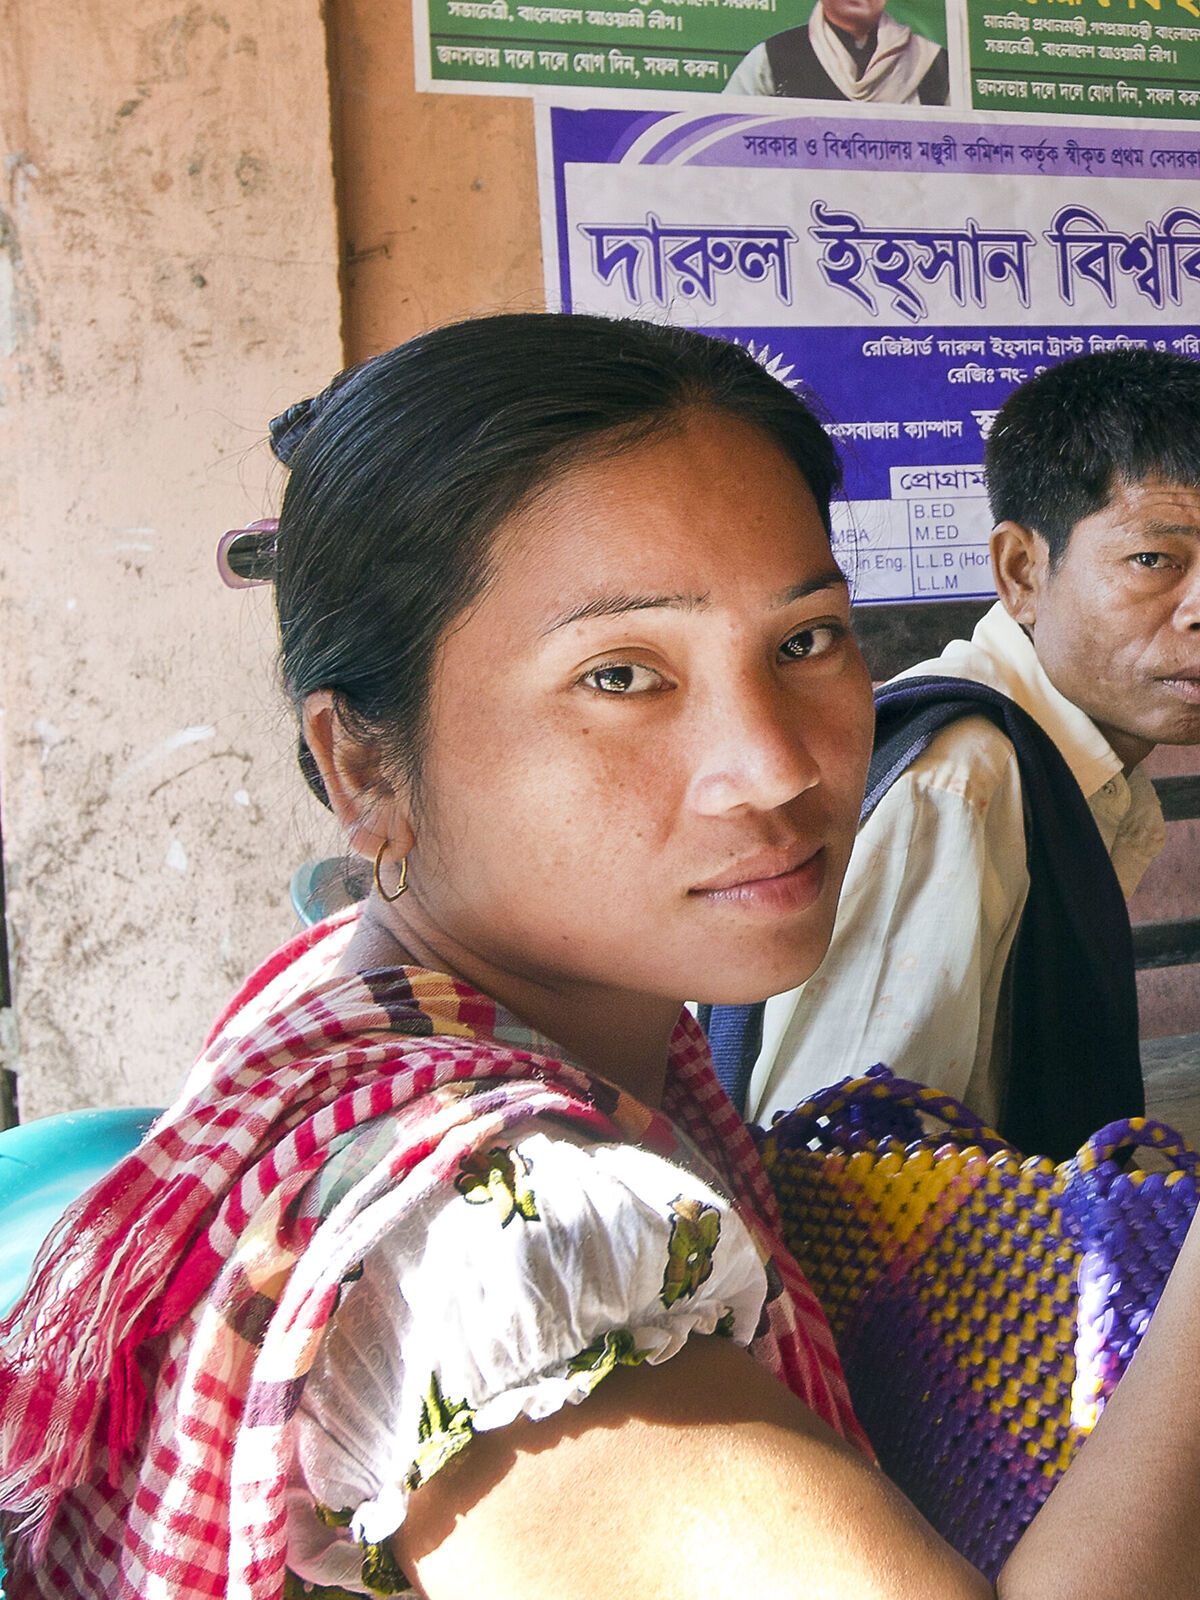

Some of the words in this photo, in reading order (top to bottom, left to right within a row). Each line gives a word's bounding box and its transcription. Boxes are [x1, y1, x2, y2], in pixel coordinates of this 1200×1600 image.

[517, 5, 583, 25] বাংলাদেশ
[585, 8, 645, 28] আওয়ামী
[983, 11, 1030, 31] মাননীয়
[436, 45, 500, 68] জনসভায়
[504, 49, 535, 69] দলে
[538, 51, 569, 72] দলে
[572, 52, 605, 74] যোগ
[608, 48, 641, 79] দিন,
[643, 56, 679, 77] সফল
[1041, 43, 1095, 58] বাংলাদেশ
[1098, 44, 1146, 62] আওয়ামী
[976, 79, 1028, 98] জনসভায়
[1030, 82, 1056, 100] দলে
[1059, 84, 1084, 101] দলে
[1087, 85, 1114, 102] যোগ
[1116, 81, 1143, 107] দিন,
[1145, 88, 1175, 105] সফল
[743, 135, 798, 157] সরকার
[804, 138, 817, 156] ও
[823, 131, 912, 160] বিশ্ববিদ্যালয়
[963, 137, 1014, 164] কমিশন
[1020, 138, 1058, 173] কর্তৃক
[1064, 139, 1106, 174] স্বীকৃত
[1111, 147, 1144, 166] প্রথম
[577, 211, 798, 309] দারুল
[937, 339, 985, 356] দারুল
[1046, 336, 1083, 357] ট্রাস্ট
[1153, 339, 1167, 353] ও
[903, 420, 963, 439] ক্যাম্পাস
[914, 503, 955, 519] B.ED
[916, 525, 959, 541] M.ED
[875, 554, 907, 572] Eng.
[916, 553, 954, 569] L.L.B
[917, 575, 958, 591] L.L.M
